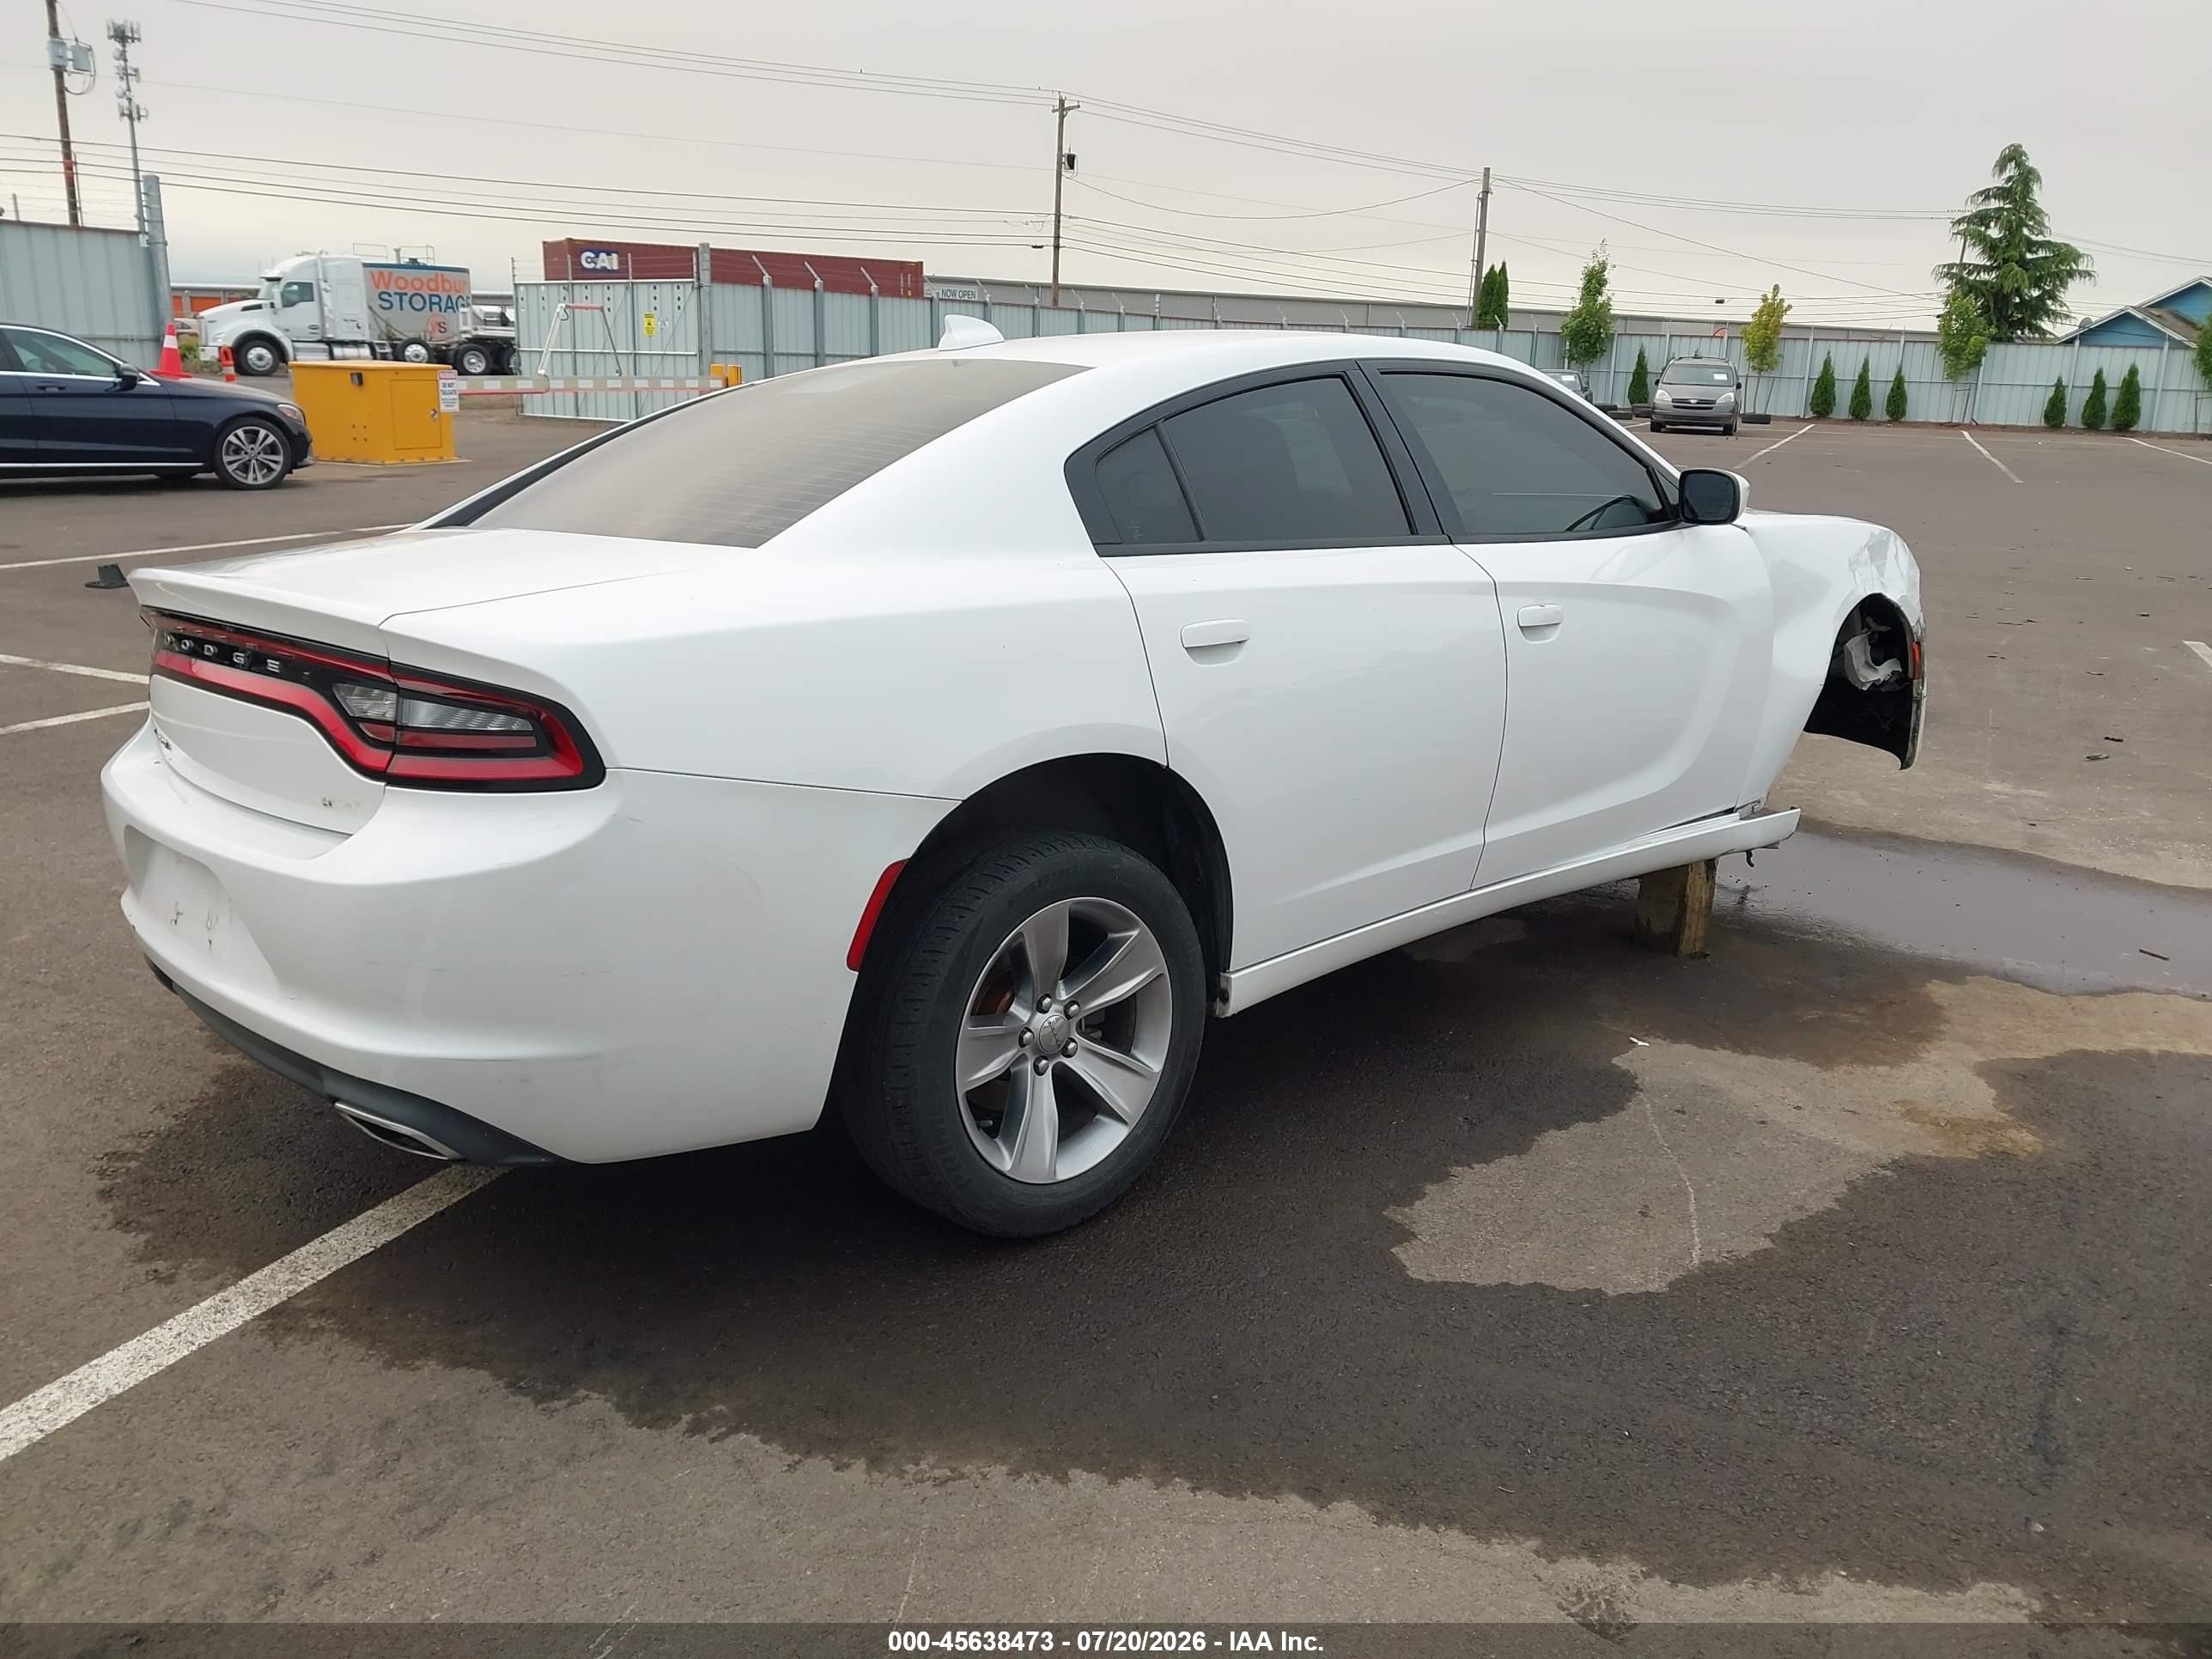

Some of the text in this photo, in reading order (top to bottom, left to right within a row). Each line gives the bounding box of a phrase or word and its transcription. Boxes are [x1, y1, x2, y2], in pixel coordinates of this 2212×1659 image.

[580, 251, 619, 270] CAI
[941, 289, 976, 300] NOW OPEN
[164, 632, 280, 673] DODGE
